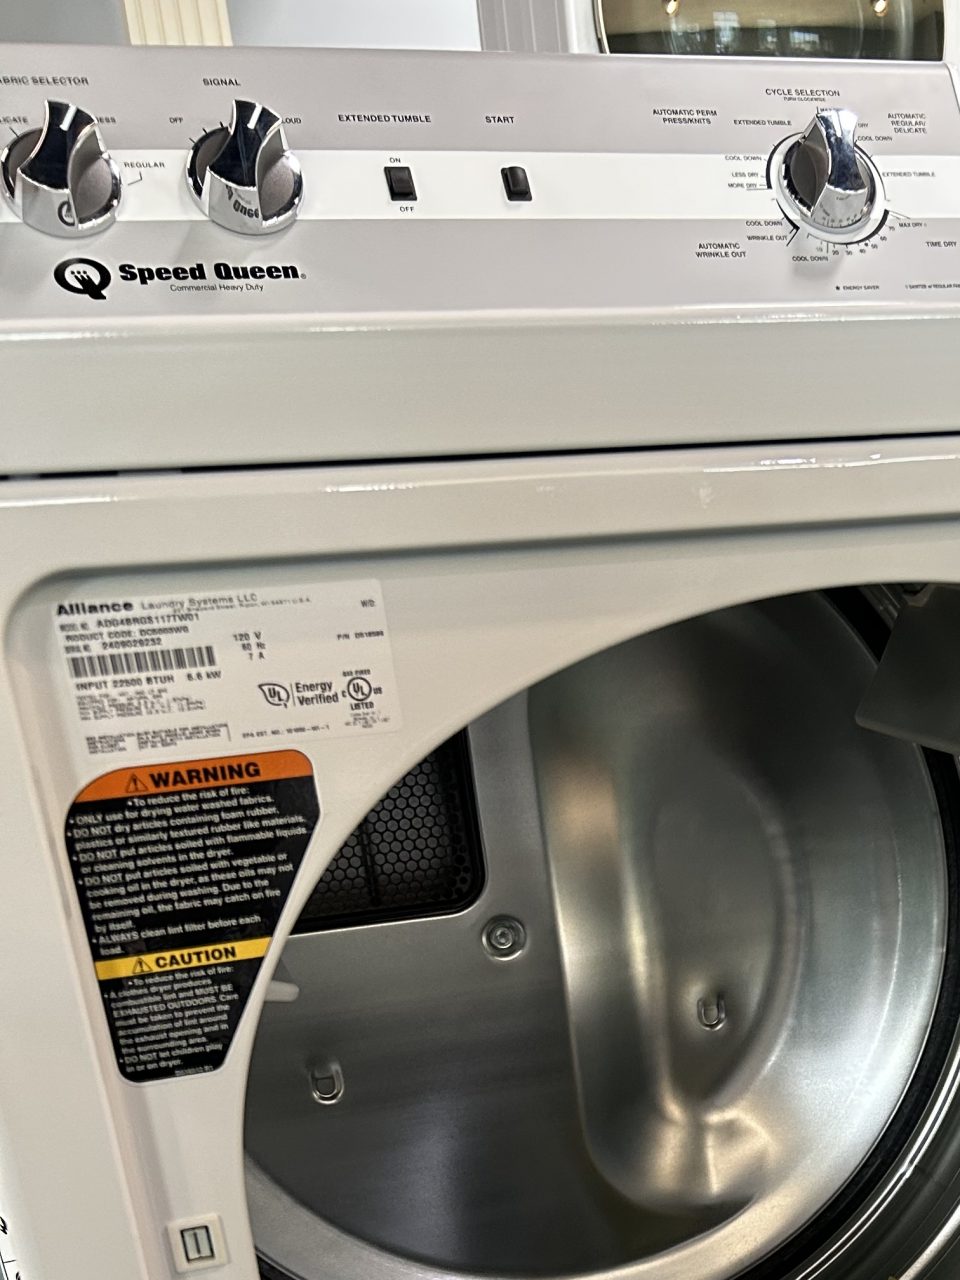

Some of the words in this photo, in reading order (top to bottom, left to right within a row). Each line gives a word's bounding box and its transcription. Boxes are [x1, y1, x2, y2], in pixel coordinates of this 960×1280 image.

[31, 77, 89, 86] SELECTOR
[202, 77, 241, 87] SIGNAL
[765, 88, 793, 96] CYCLE
[794, 89, 840, 97] SELECTION
[696, 109, 718, 117] PERM
[887, 112, 927, 120] AUTOMATIC
[338, 114, 391, 123] EXTENDED
[392, 114, 432, 123] TUMBLE
[485, 115, 515, 124] START
[662, 117, 712, 125] PRESS/KNITS
[893, 127, 928, 135] DELICATE
[123, 161, 166, 169] REGULAR
[698, 242, 740, 250] AUTOMATIC
[118, 262, 208, 285] Speed
[169, 283, 218, 292] Commercial
[219, 283, 244, 292] Heavy
[246, 283, 264, 292] Duty
[57, 600, 134, 616] Alliance
[140, 600, 185, 611] Laundry
[188, 597, 234, 608] Systems
[236, 593, 258, 603] LLC
[232, 633, 250, 642] 120
[254, 632, 262, 641] V
[75, 680, 109, 691] INPUT
[295, 681, 333, 695] Energy
[352, 683, 367, 697] UL
[267, 687, 284, 702] UL
[297, 691, 340, 707] Verified
[149, 762, 261, 788] WARNING
[198, 788, 218, 799] risk
[218, 787, 229, 797] of
[155, 946, 237, 968] CAUTION
